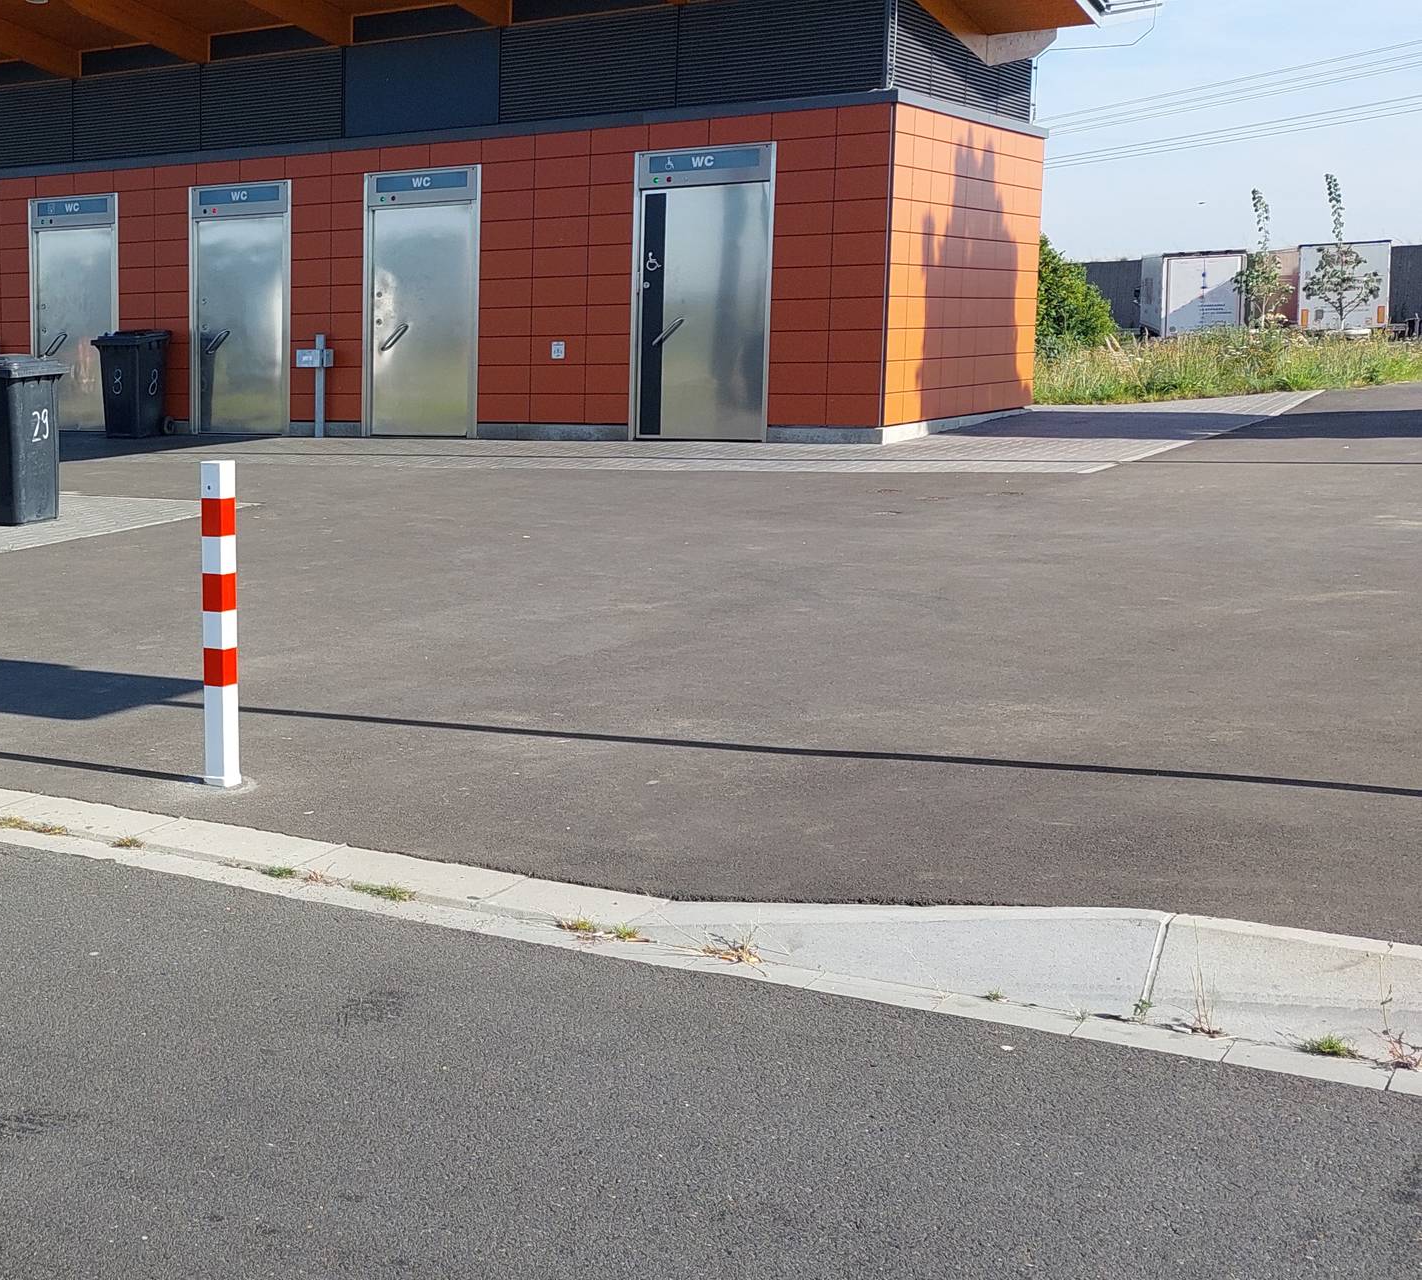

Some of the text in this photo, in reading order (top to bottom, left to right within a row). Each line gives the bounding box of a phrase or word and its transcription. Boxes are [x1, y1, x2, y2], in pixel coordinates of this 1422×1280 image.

[691, 155, 715, 168] WC
[412, 176, 430, 188] WC
[231, 190, 248, 201] WC
[65, 202, 80, 212] WC
[112, 368, 123, 395] 8
[148, 368, 159, 396] 8
[31, 408, 50, 442] 29
